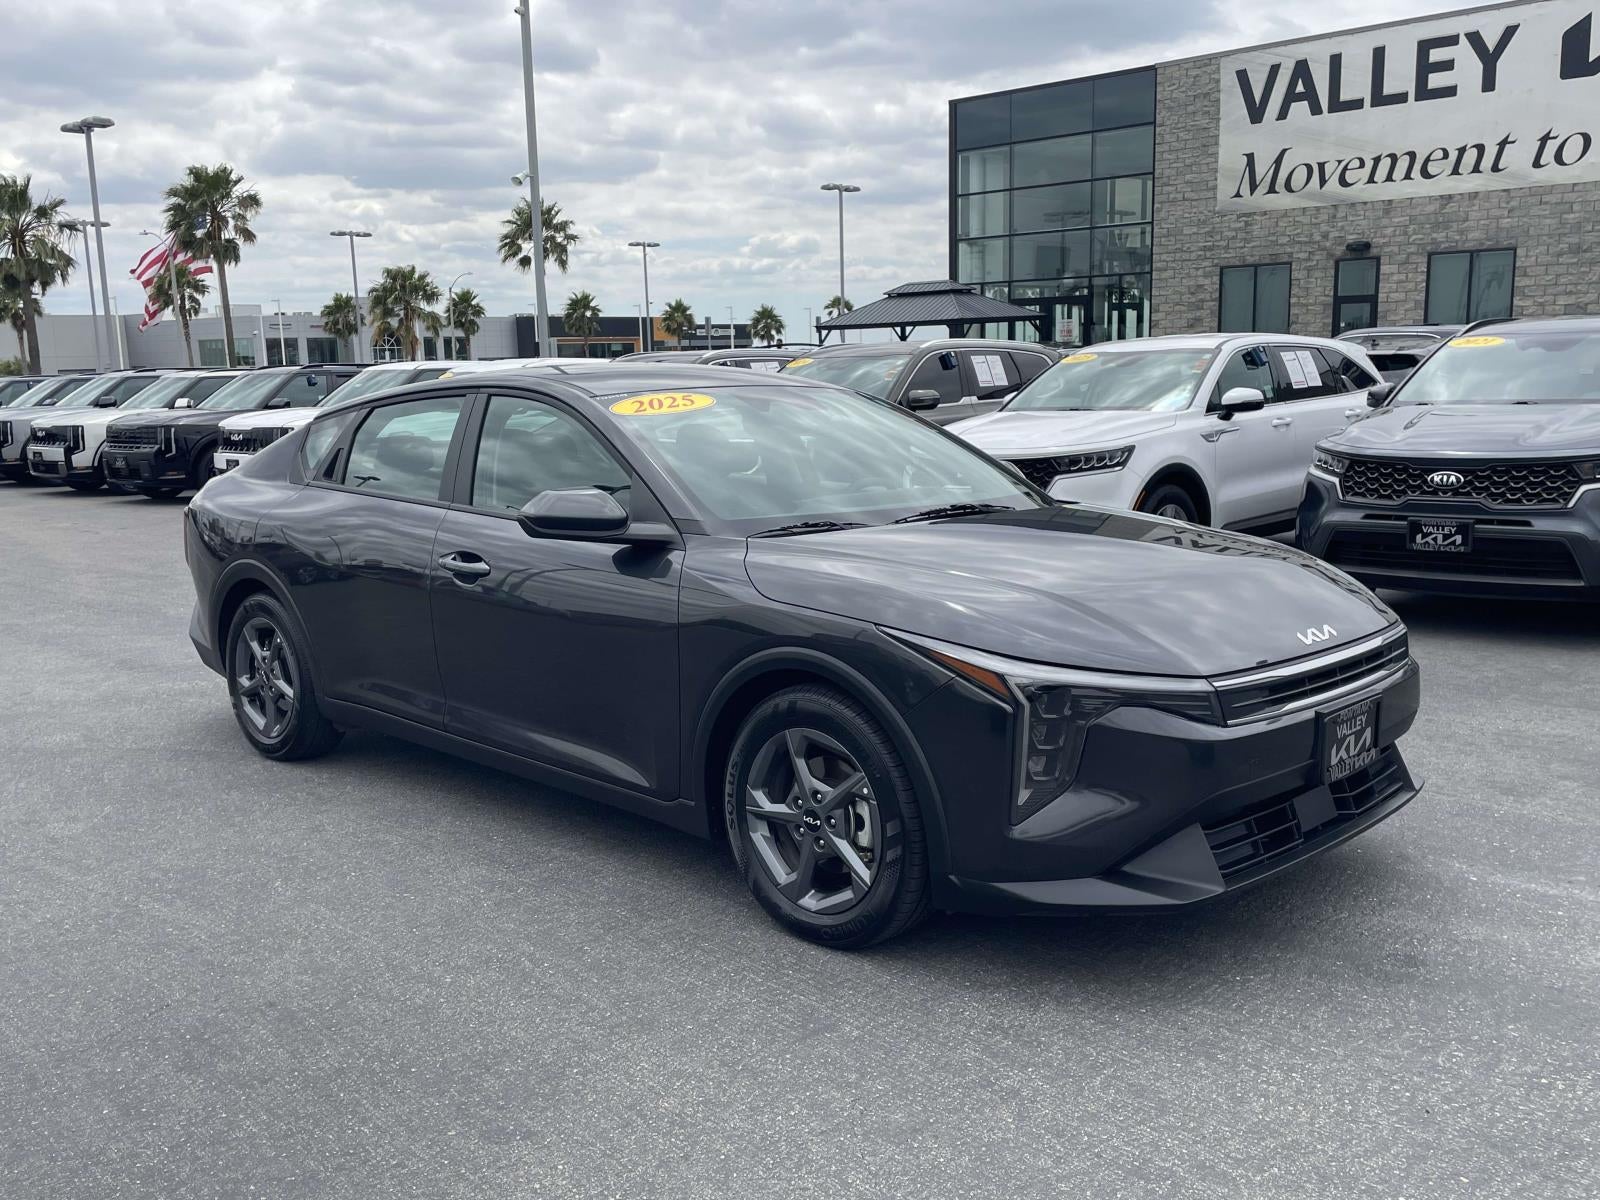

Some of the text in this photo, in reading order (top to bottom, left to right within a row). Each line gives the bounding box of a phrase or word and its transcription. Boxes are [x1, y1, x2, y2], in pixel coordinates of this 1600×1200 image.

[1235, 23, 1520, 124] VALLEY
[1230, 127, 1593, 199] Movement to
[631, 394, 695, 413] 2025
[1433, 474, 1458, 486] KIA
[1415, 533, 1462, 545] KIA
[1422, 526, 1457, 534] VALLEY
[1413, 543, 1439, 551] VALLEY
[1296, 624, 1338, 645] KIA
[1336, 712, 1368, 740] VALLEY
[1330, 726, 1372, 766] KIA
[1329, 758, 1355, 782] VALLEY
[803, 815, 821, 826] KIA
